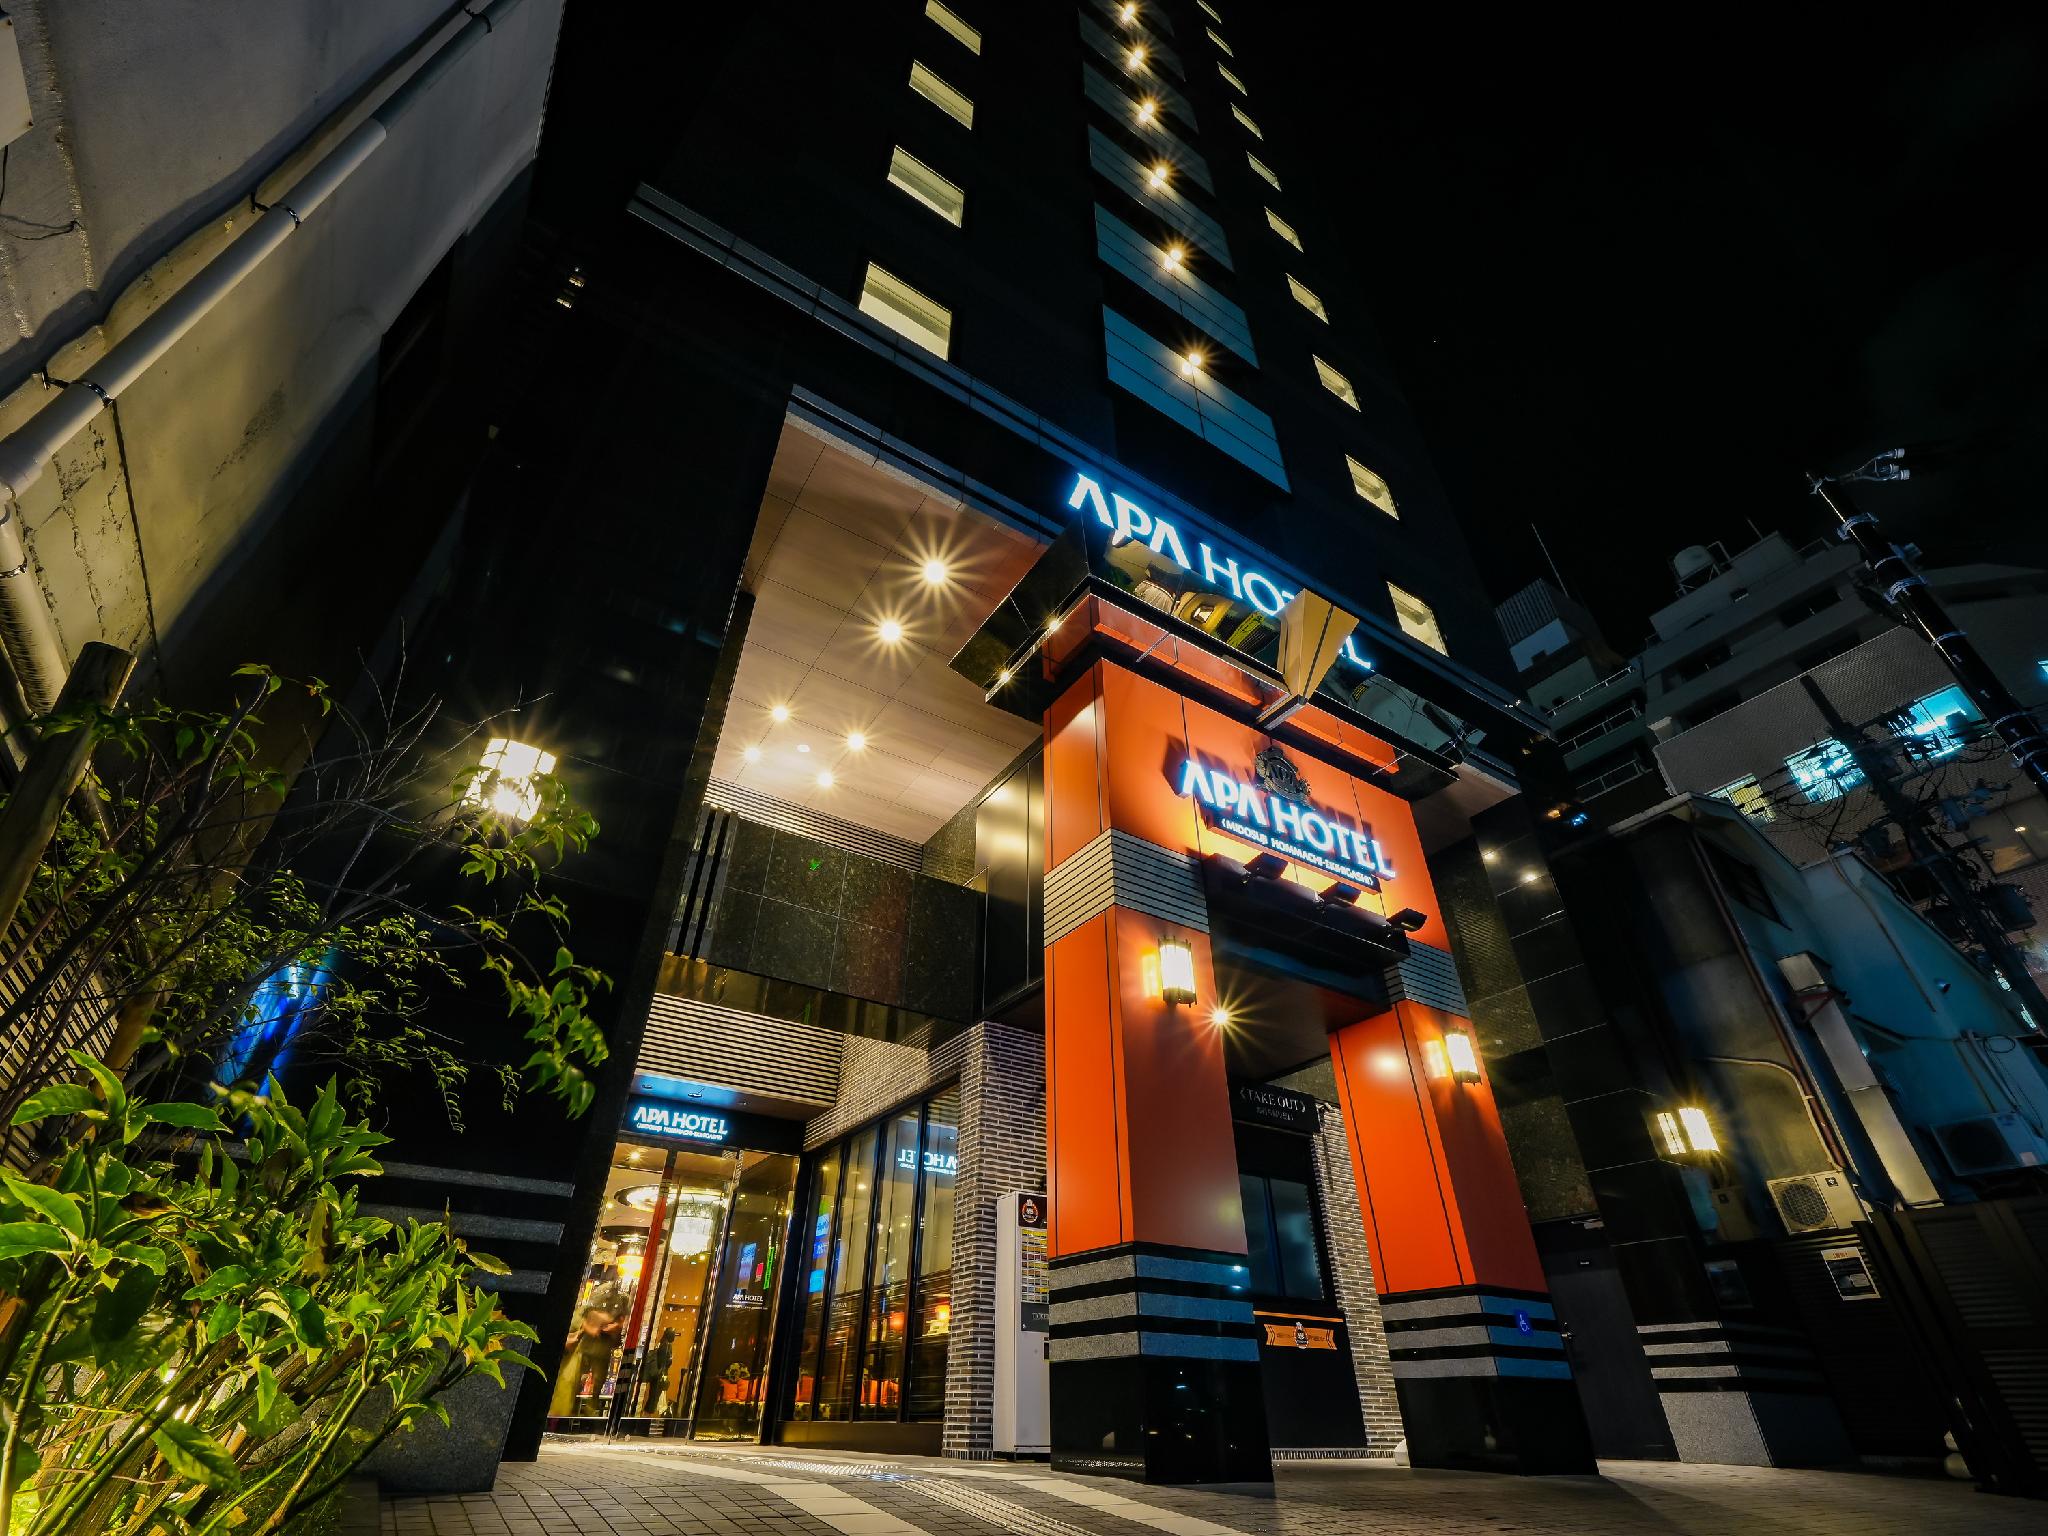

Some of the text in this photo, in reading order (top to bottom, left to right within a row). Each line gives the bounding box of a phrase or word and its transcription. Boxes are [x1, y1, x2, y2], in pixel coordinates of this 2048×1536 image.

[1069, 473, 1371, 669] APA HOL
[1182, 761, 1395, 879] APA HOTEL
[633, 1106, 669, 1126] APA
[672, 1112, 728, 1135] HOTEL
[745, 1294, 763, 1302] HOTEL
